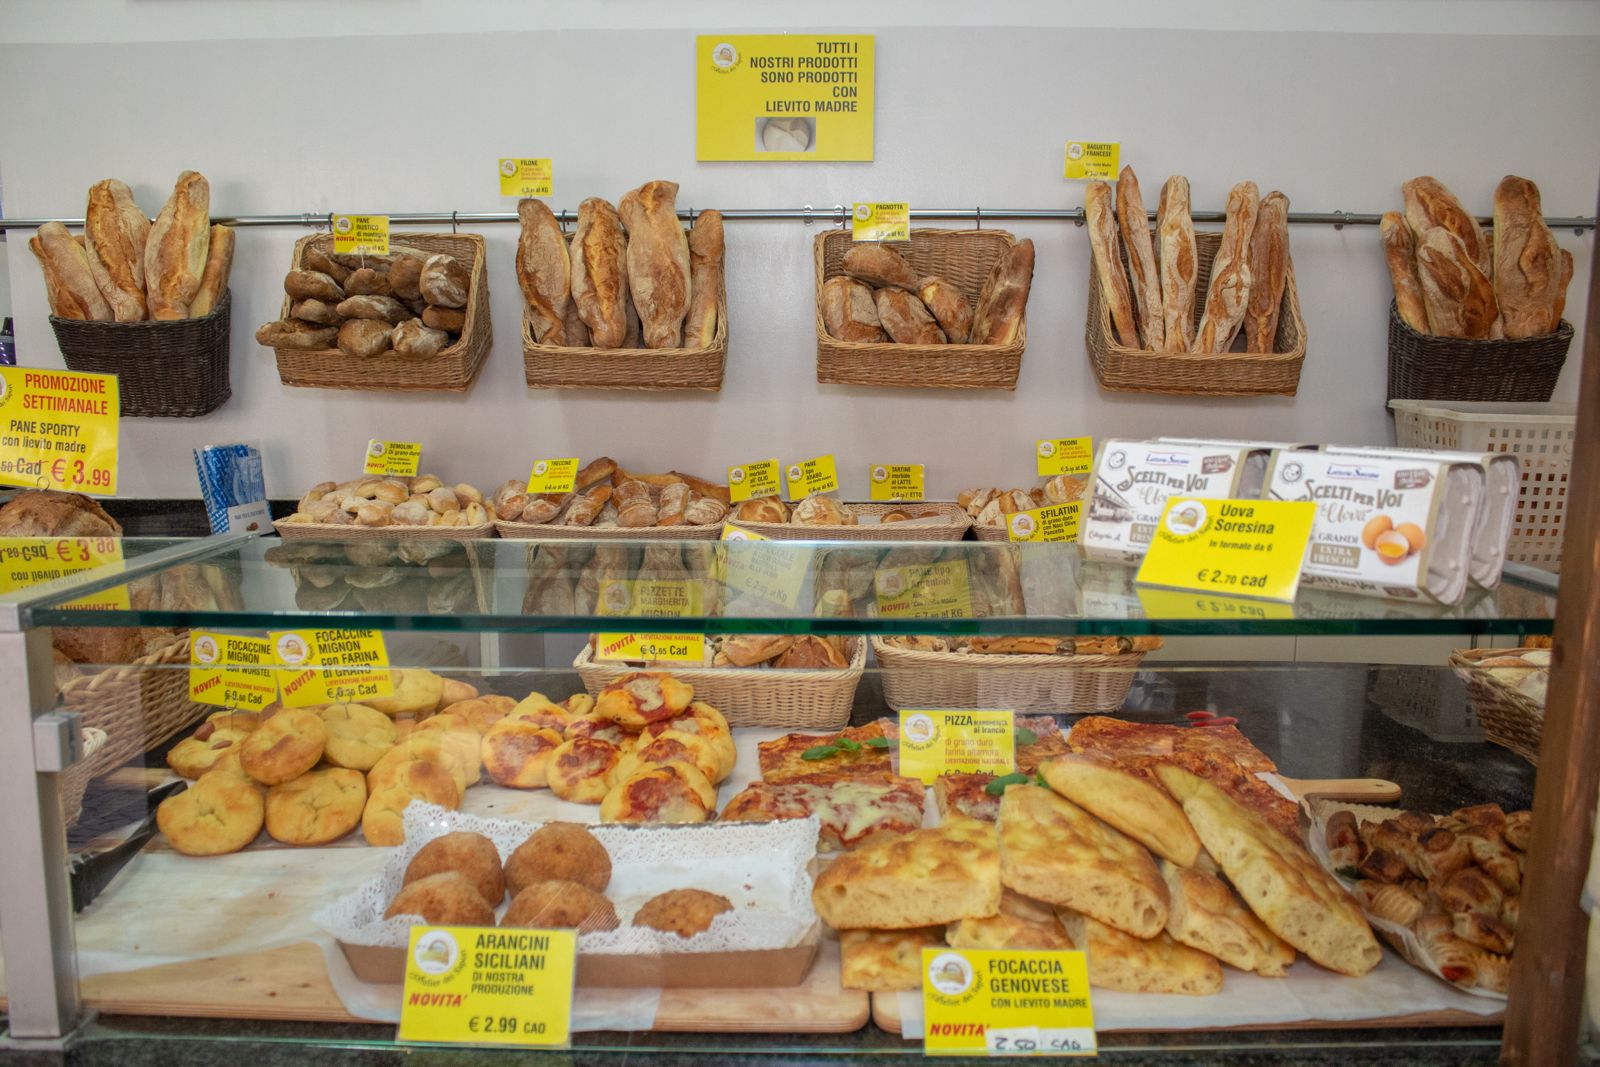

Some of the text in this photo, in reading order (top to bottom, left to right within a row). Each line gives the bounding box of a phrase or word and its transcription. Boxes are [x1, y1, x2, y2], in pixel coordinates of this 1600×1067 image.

[817, 42, 858, 54] TUTTI I
[750, 57, 858, 68] NOSTRI PRODOTTI
[761, 72, 858, 83] SONO PRODOTTI
[833, 86, 858, 98] CON
[766, 100, 858, 112] LIEVITO MADRE
[25, 373, 106, 394] PROMOZIONE
[23, 394, 108, 416] SETTIMANALE
[10, 420, 80, 438] PANE SPORTY
[2, 436, 86, 454] con lievito madre
[748, 462, 770, 471] TRECCINA
[804, 460, 816, 469] PANE
[16, 458, 111, 487] Cad € 3.99
[806, 472, 822, 482] ARABO
[1116, 466, 1208, 493] SCELTI PER VOI
[1295, 478, 1403, 509] SCELTI PER VOI
[1040, 505, 1079, 519] SFILATINI
[1220, 504, 1254, 520] Uova
[1214, 518, 1274, 536] Soresina
[1318, 532, 1359, 546] GRANDI
[1209, 540, 1273, 554] In formato da 6
[1320, 545, 1352, 556] EXTRA
[1198, 568, 1267, 590] € 2.70 cad
[640, 586, 685, 597] PIZZETTE
[640, 598, 689, 606] MARGHERITA
[951, 608, 963, 618] KG
[315, 630, 374, 643] FOCACCINE
[227, 640, 271, 656] FOCACCINE
[318, 640, 361, 654] MIGNON
[670, 645, 688, 656] Cad
[227, 651, 260, 664] MIGNON
[321, 650, 380, 667] con FARINA
[327, 684, 378, 698] € Cad
[248, 693, 262, 704] Cad
[944, 715, 973, 726] PIZZA
[954, 739, 974, 748] grano
[476, 934, 550, 952] ARANCINI
[474, 952, 545, 970] SICILIANI
[989, 960, 1063, 975] FOCACCIA
[472, 972, 524, 983] DI NOSTRA
[471, 984, 534, 996] PRODUZIONE
[990, 978, 1070, 993] GENOVESE
[408, 993, 468, 1008] NOVITA'
[991, 998, 1088, 1008] CON LIEVITO MADRE
[469, 1016, 546, 1034] € 2.99 CAD
[930, 1023, 990, 1037] NOVITA'
[995, 1036, 1081, 1051] 2.50 CAD
